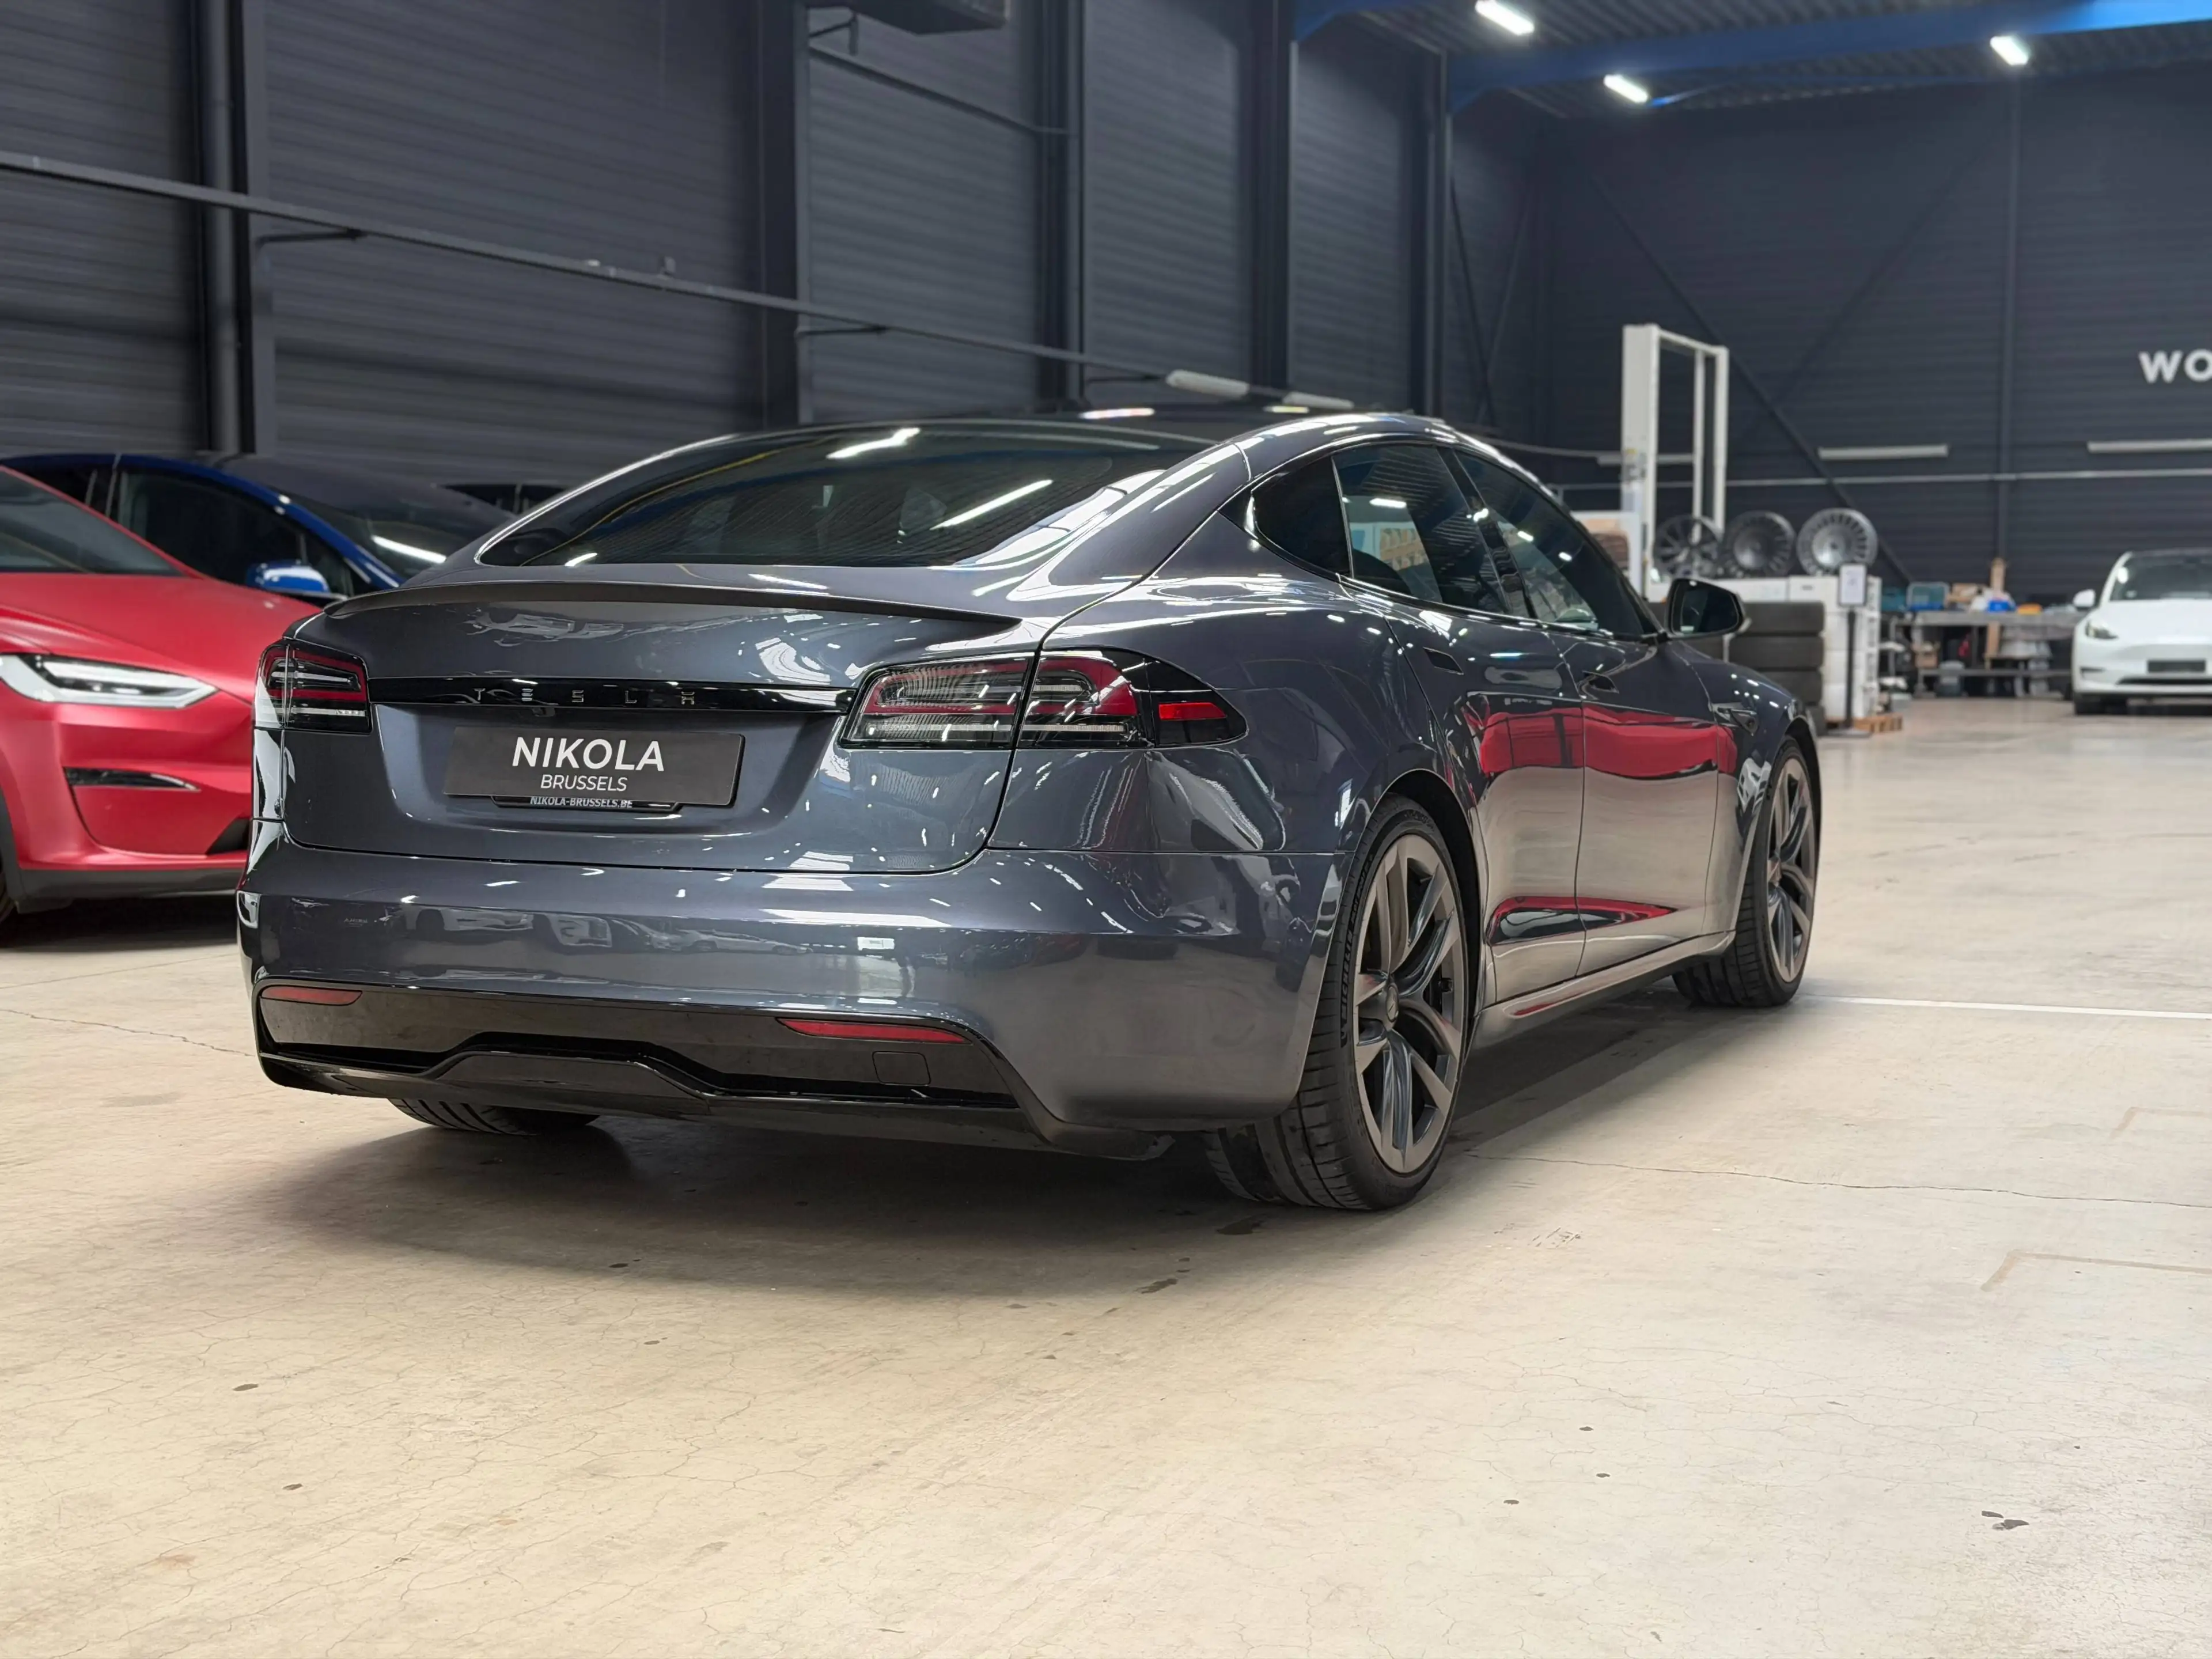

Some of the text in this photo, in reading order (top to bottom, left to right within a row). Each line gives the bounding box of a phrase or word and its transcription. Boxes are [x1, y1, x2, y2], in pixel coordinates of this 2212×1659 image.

[2138, 349, 2212, 384] WO
[474, 688, 695, 705] TESLA
[512, 737, 665, 772] NIKOLA
[540, 774, 628, 792] BRUSSELS
[530, 796, 633, 808] NIKOLA-BRUSSELS.BE
